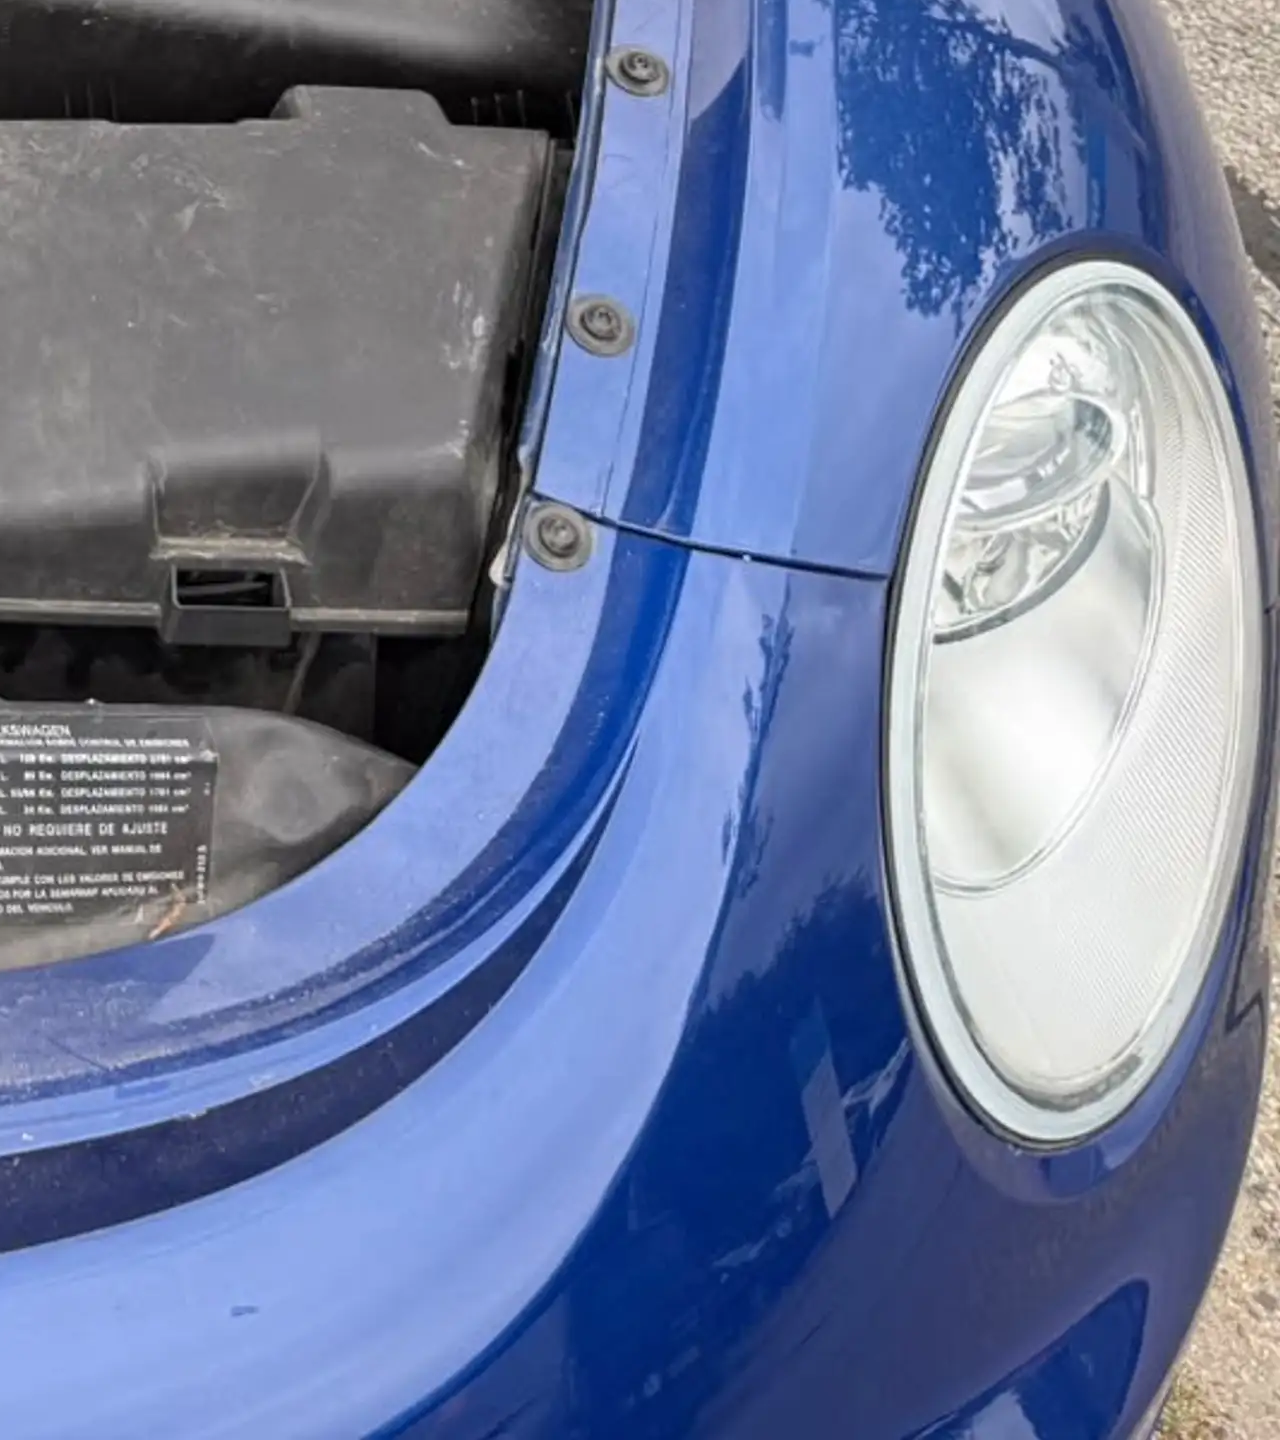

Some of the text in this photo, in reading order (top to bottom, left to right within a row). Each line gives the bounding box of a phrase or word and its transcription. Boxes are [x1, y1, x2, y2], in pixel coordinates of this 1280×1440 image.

[3, 824, 21, 837] NO
[29, 822, 91, 837] REQUIERE
[99, 822, 115, 836] DE
[122, 821, 168, 835] AJUSTE
